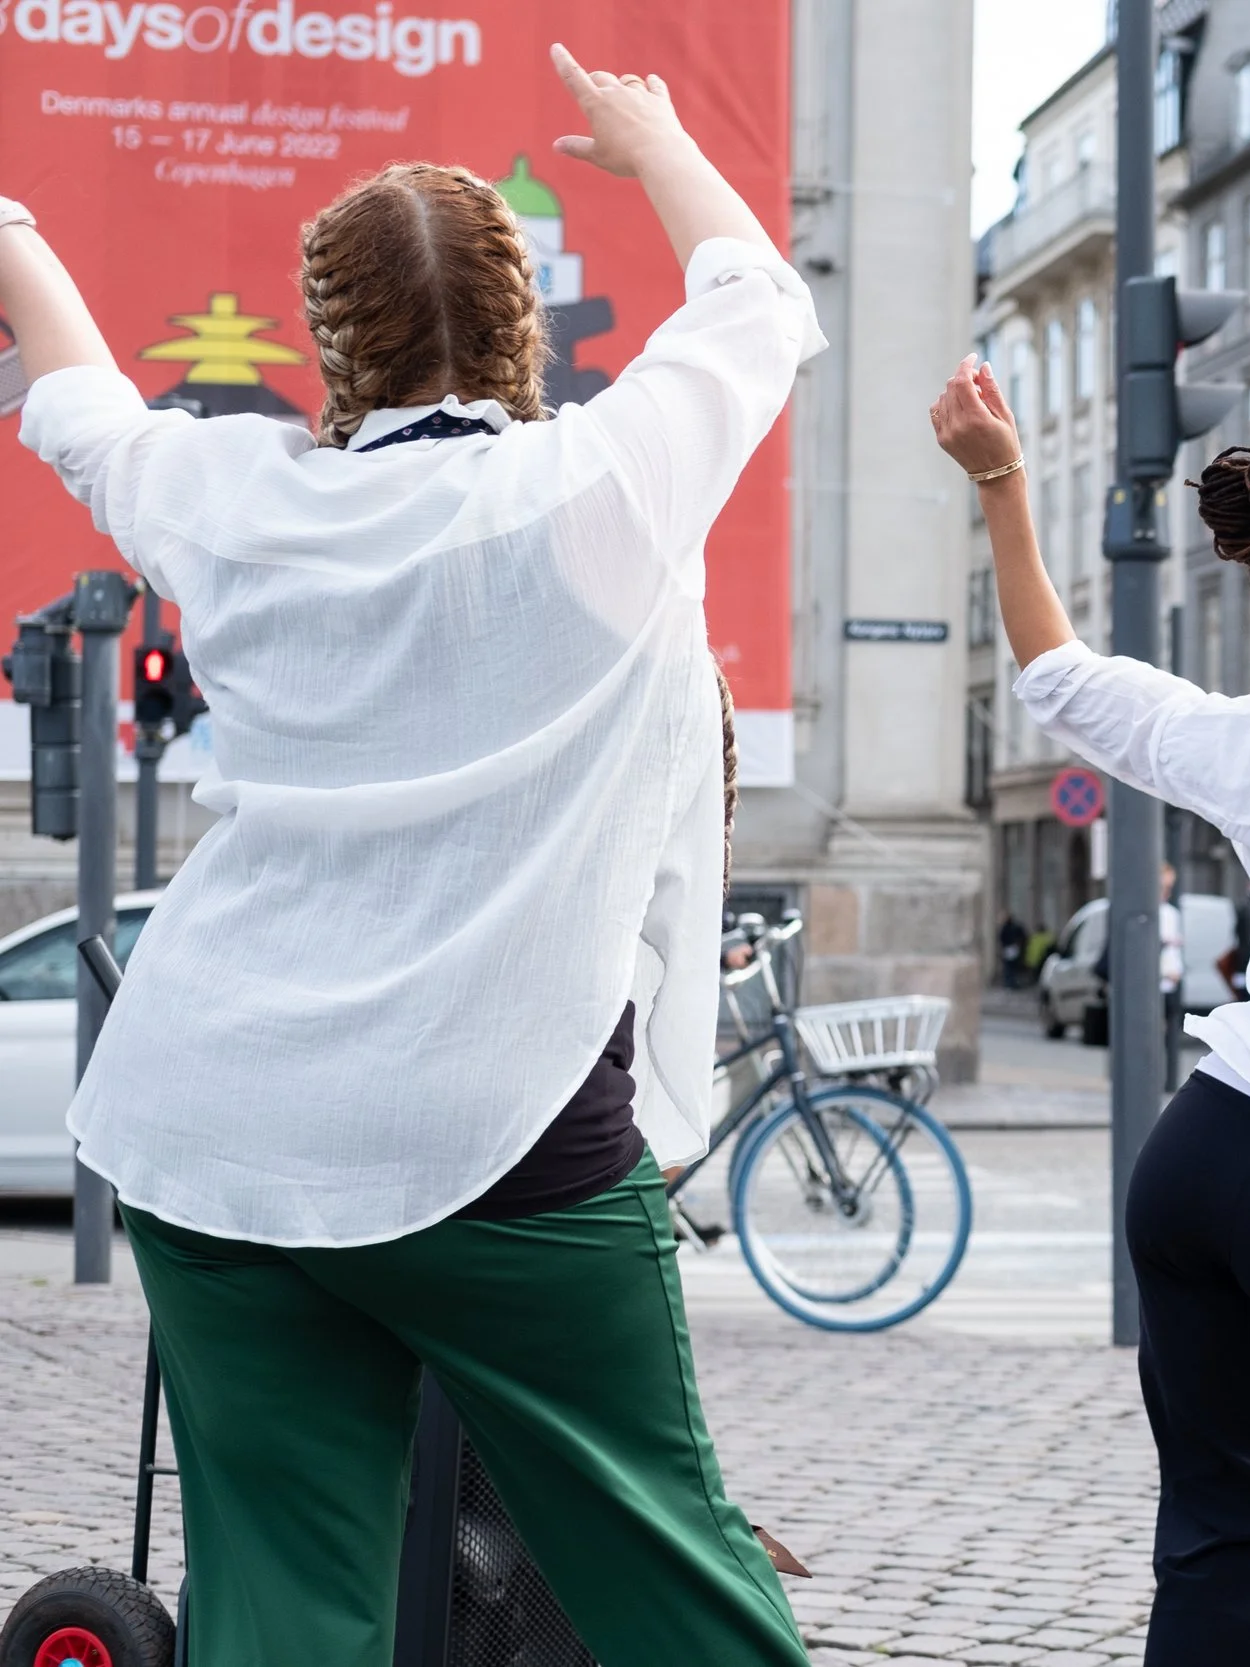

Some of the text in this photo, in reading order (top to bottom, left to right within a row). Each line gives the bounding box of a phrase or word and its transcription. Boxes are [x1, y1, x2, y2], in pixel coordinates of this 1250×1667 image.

[41, 89, 164, 120] Denmarks
[168, 101, 248, 124] annual
[252, 101, 327, 131] design
[112, 125, 143, 150] 15
[181, 128, 213, 153] 17
[215, 130, 276, 156] June
[279, 132, 341, 159] 2022
[154, 157, 296, 190] Copenhagen
